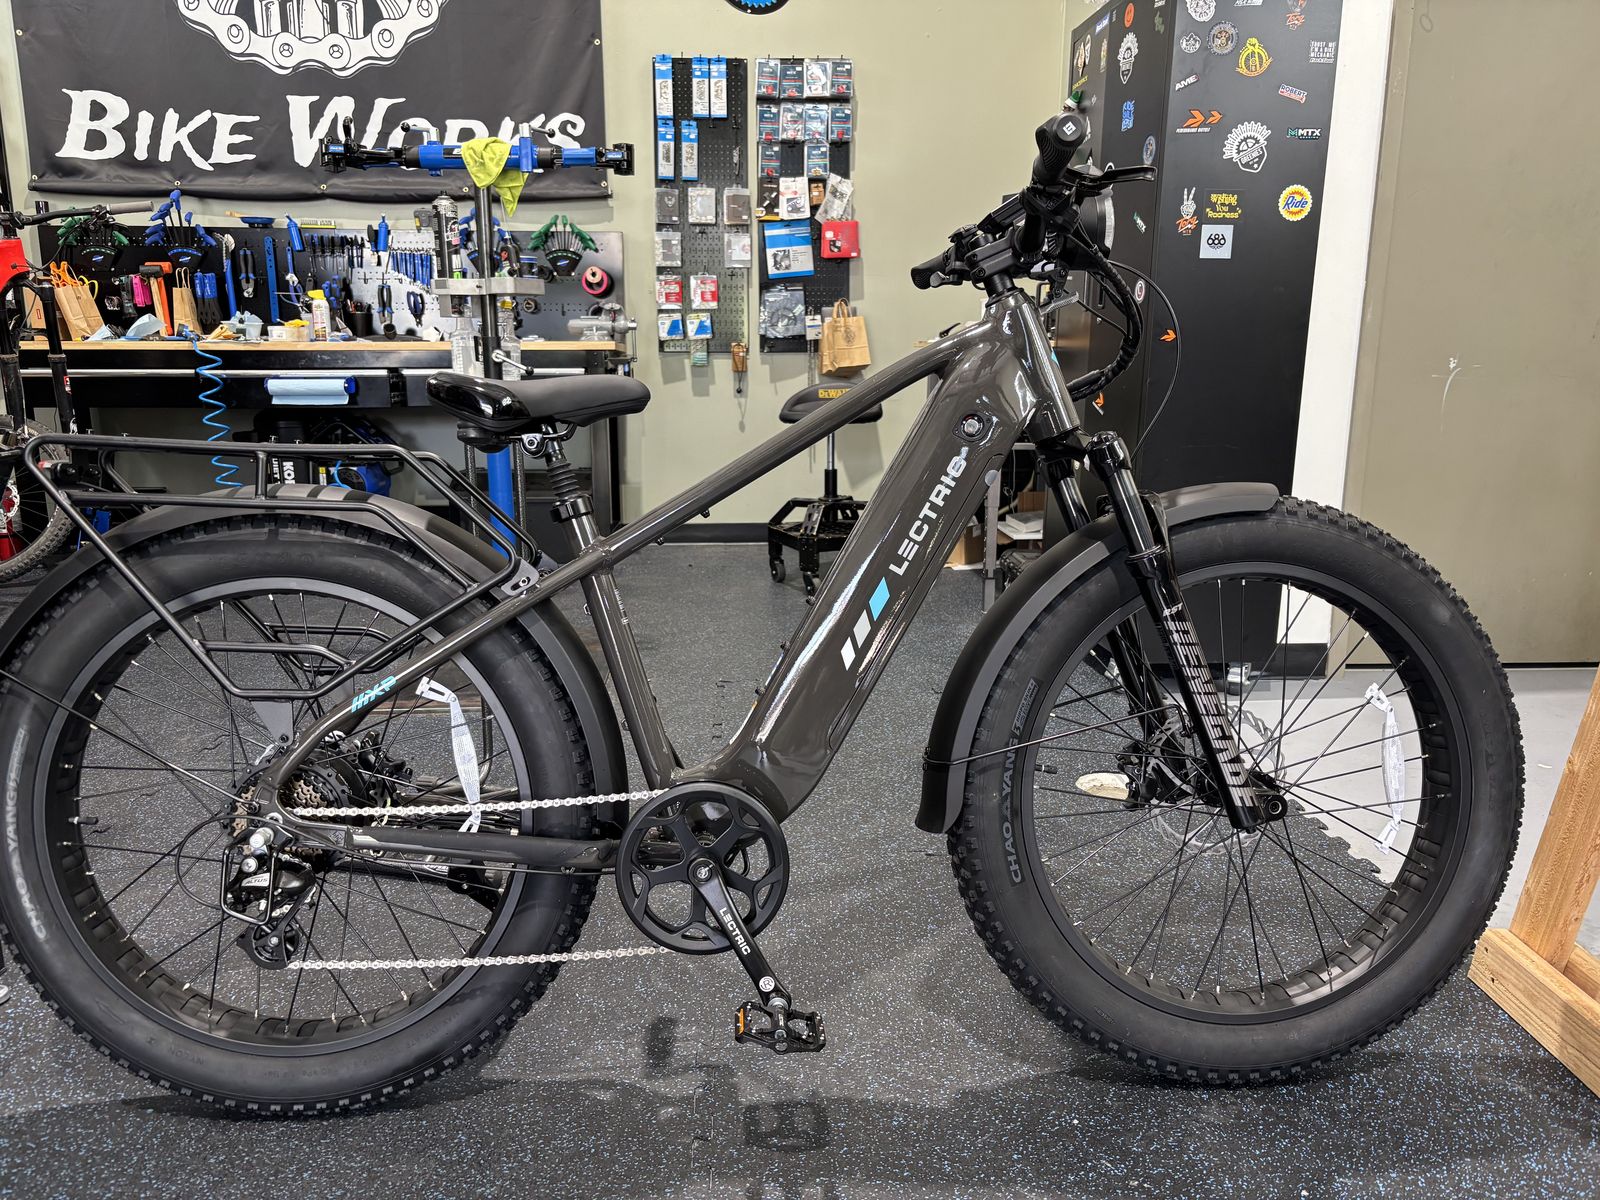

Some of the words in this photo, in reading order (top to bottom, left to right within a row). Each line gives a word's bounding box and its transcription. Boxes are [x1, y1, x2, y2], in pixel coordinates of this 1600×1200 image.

[1281, 85, 1307, 98] ROBERT
[55, 88, 260, 171] BIKE
[1298, 128, 1321, 136] MTX
[1282, 195, 1308, 210] Ride
[1207, 233, 1226, 246] 686
[888, 454, 968, 577] LECTRIC
[1162, 602, 1184, 618] RST
[1162, 620, 1260, 807] RENEGADE
[1001, 737, 1019, 798] YANG
[6, 791, 19, 852] YANG
[1002, 821, 1022, 884] CHAO
[719, 907, 751, 956] LECTRIC
